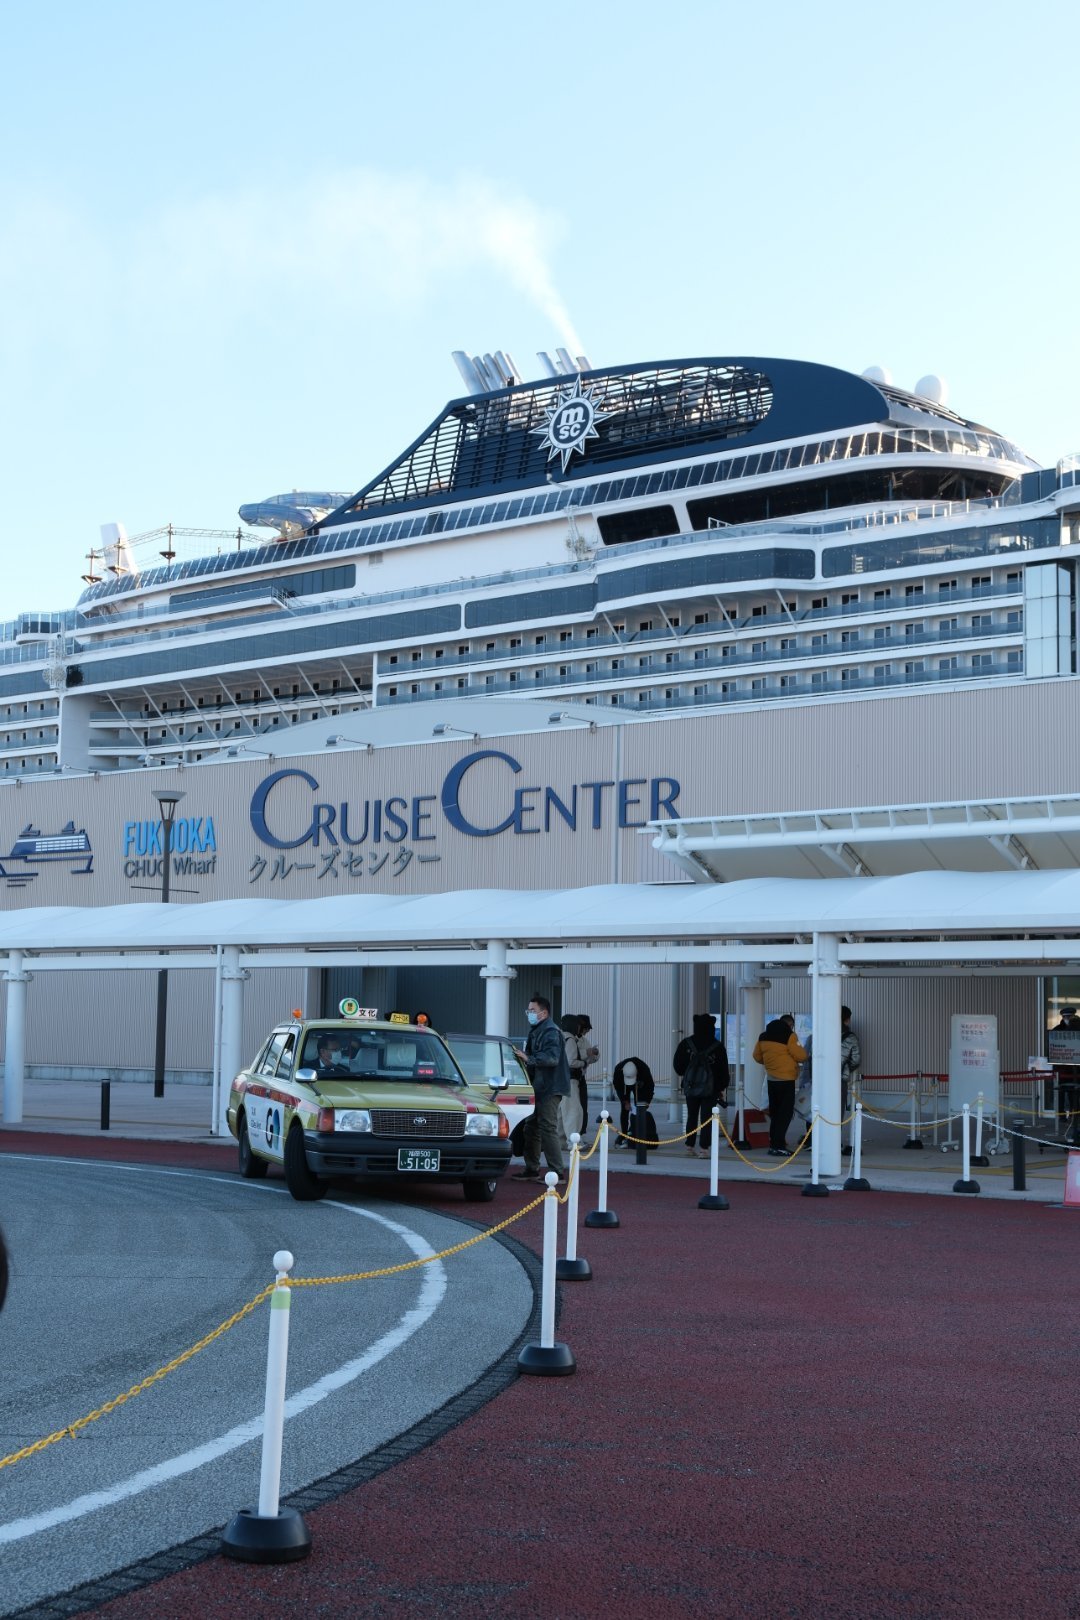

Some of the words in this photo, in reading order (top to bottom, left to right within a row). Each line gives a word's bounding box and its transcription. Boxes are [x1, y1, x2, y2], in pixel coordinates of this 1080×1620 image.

[250, 768, 437, 850] CRUISE
[441, 749, 682, 837] CENTER
[173, 855, 217, 876] Wharf
[249, 846, 441, 883] クルーズセンター
[359, 1008, 376, 1018] 文化
